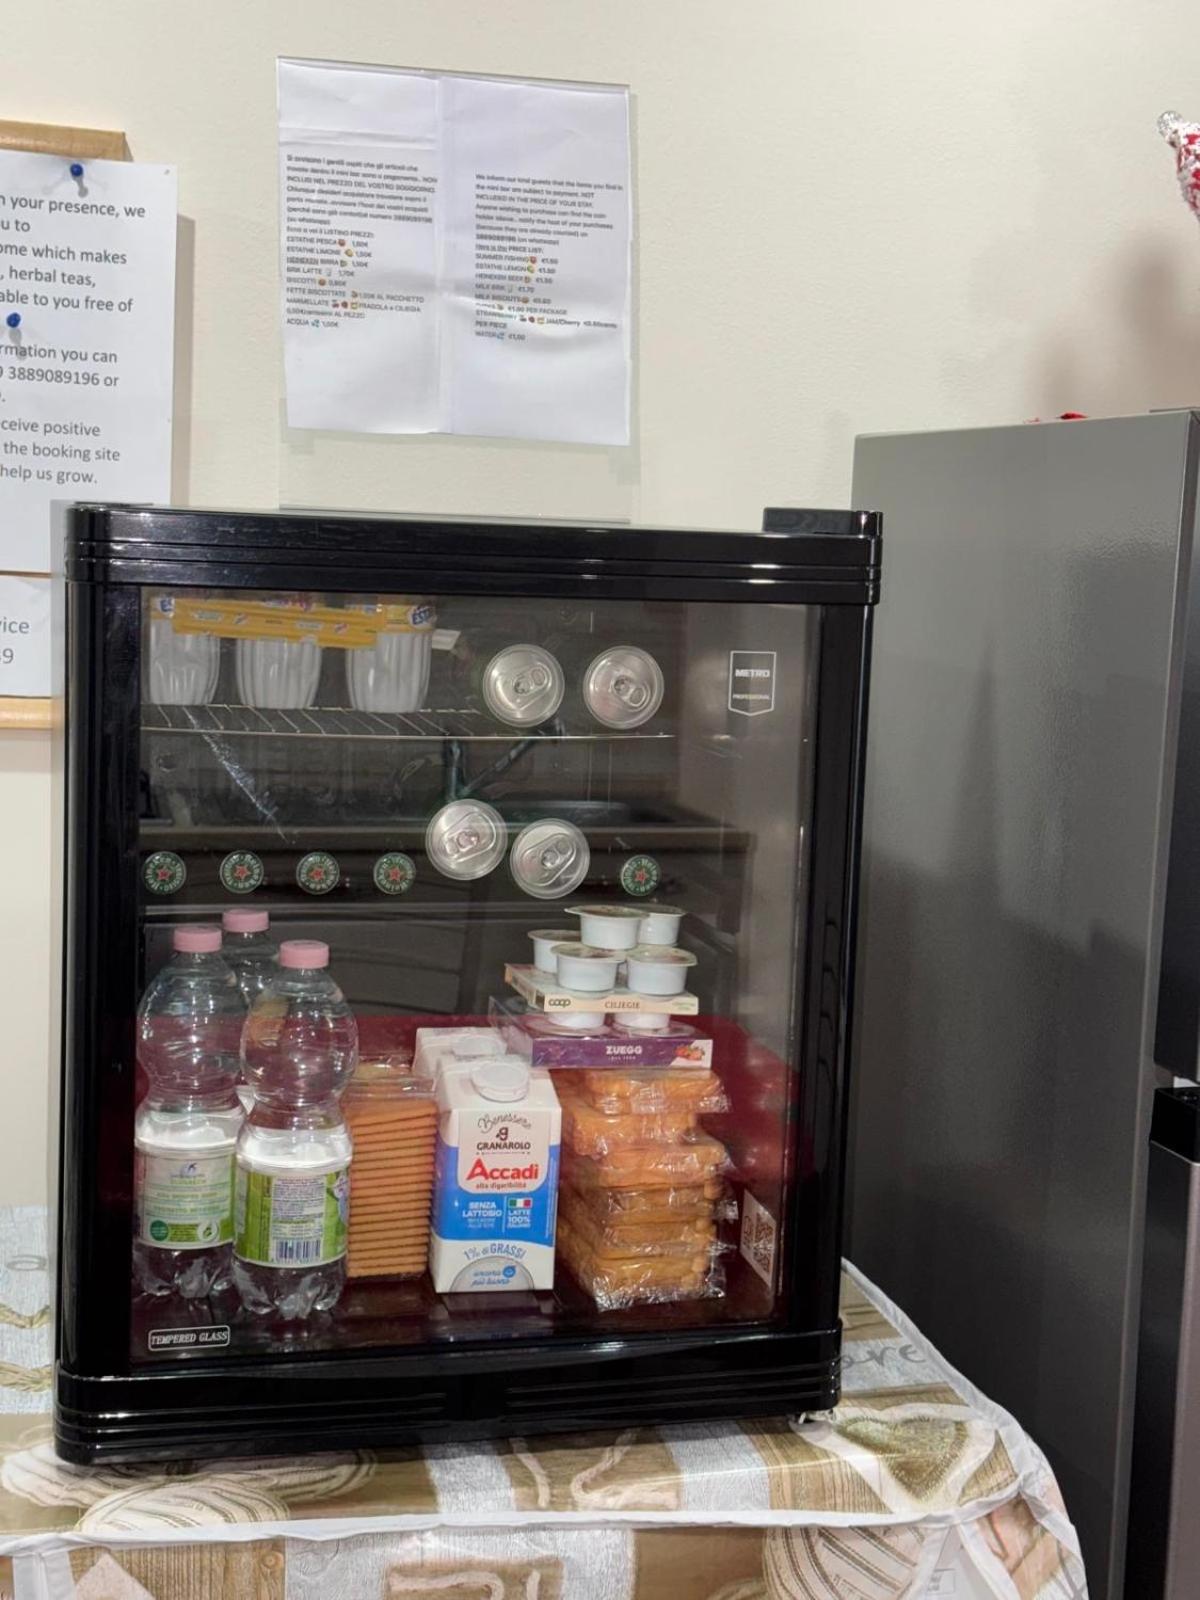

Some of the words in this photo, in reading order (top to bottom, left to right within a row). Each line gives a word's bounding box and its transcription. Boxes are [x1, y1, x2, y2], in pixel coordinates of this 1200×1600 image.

[10, 196, 44, 210] your
[49, 200, 120, 218] presence,
[123, 205, 146, 217] we
[15, 219, 31, 232] to
[32, 244, 76, 261] which
[80, 249, 127, 264] makes
[9, 265, 56, 283] herbal
[61, 272, 96, 288] teas,
[33, 293, 49, 306] to
[53, 296, 80, 310] you
[85, 296, 114, 311] free
[118, 299, 133, 312] of
[61, 349, 88, 363] you
[92, 351, 118, 363] can
[8, 366, 100, 386] 3889089196
[104, 375, 120, 387] or
[44, 421, 101, 437] positive
[4, 440, 29, 456] the
[33, 442, 91, 463] booking
[95, 447, 120, 461] site
[37, 470, 53, 481] us
[56, 472, 98, 485] grow.
[0, 616, 30, 635] ice
[735, 668, 770, 678] METRO
[548, 998, 571, 1008] coop
[606, 1045, 643, 1055] ZUEGG
[477, 1141, 531, 1151] GRANAROLO
[466, 1158, 538, 1181] Accadi
[469, 1201, 496, 1210] SENZA
[462, 1209, 502, 1218] LATTOSIO
[490, 1243, 527, 1260] GRASSI
[151, 1333, 196, 1345] TEMPERED
[199, 1331, 228, 1342] GLASS
